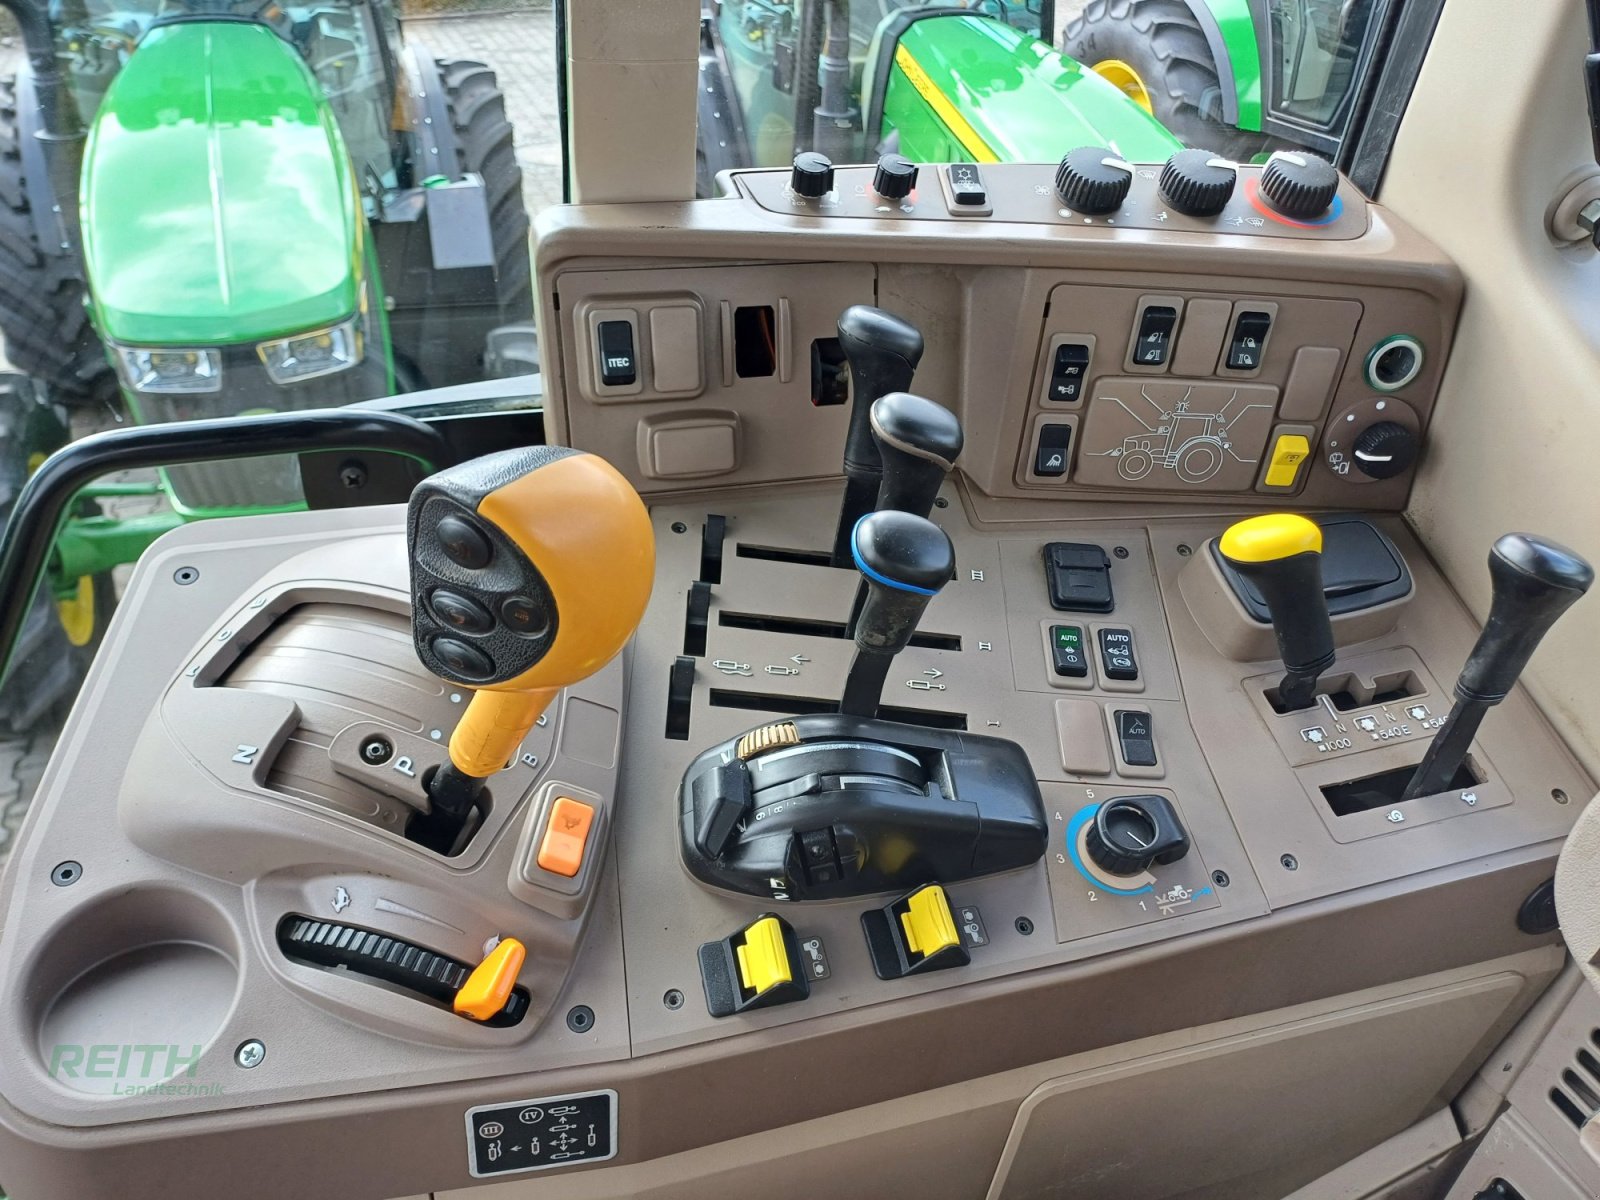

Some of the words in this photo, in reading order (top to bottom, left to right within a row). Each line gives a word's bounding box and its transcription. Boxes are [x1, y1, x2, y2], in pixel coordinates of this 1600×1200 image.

[607, 356, 630, 368] ITEC
[1060, 634, 1078, 642] AUTO
[1106, 634, 1129, 642] AUTO
[1384, 712, 1396, 722] N
[1335, 723, 1347, 733] N
[1379, 727, 1401, 740] 540
[1401, 724, 1412, 735] E
[1325, 738, 1351, 751] 1000
[231, 744, 259, 765] N
[521, 753, 538, 768] B
[393, 755, 416, 778] P
[1086, 789, 1095, 799] 5
[1055, 811, 1063, 821] 4
[1056, 853, 1066, 864] 3
[1088, 891, 1098, 902] 2
[1139, 900, 1147, 911] 1
[525, 1111, 537, 1120] IV
[483, 1126, 498, 1134] III
